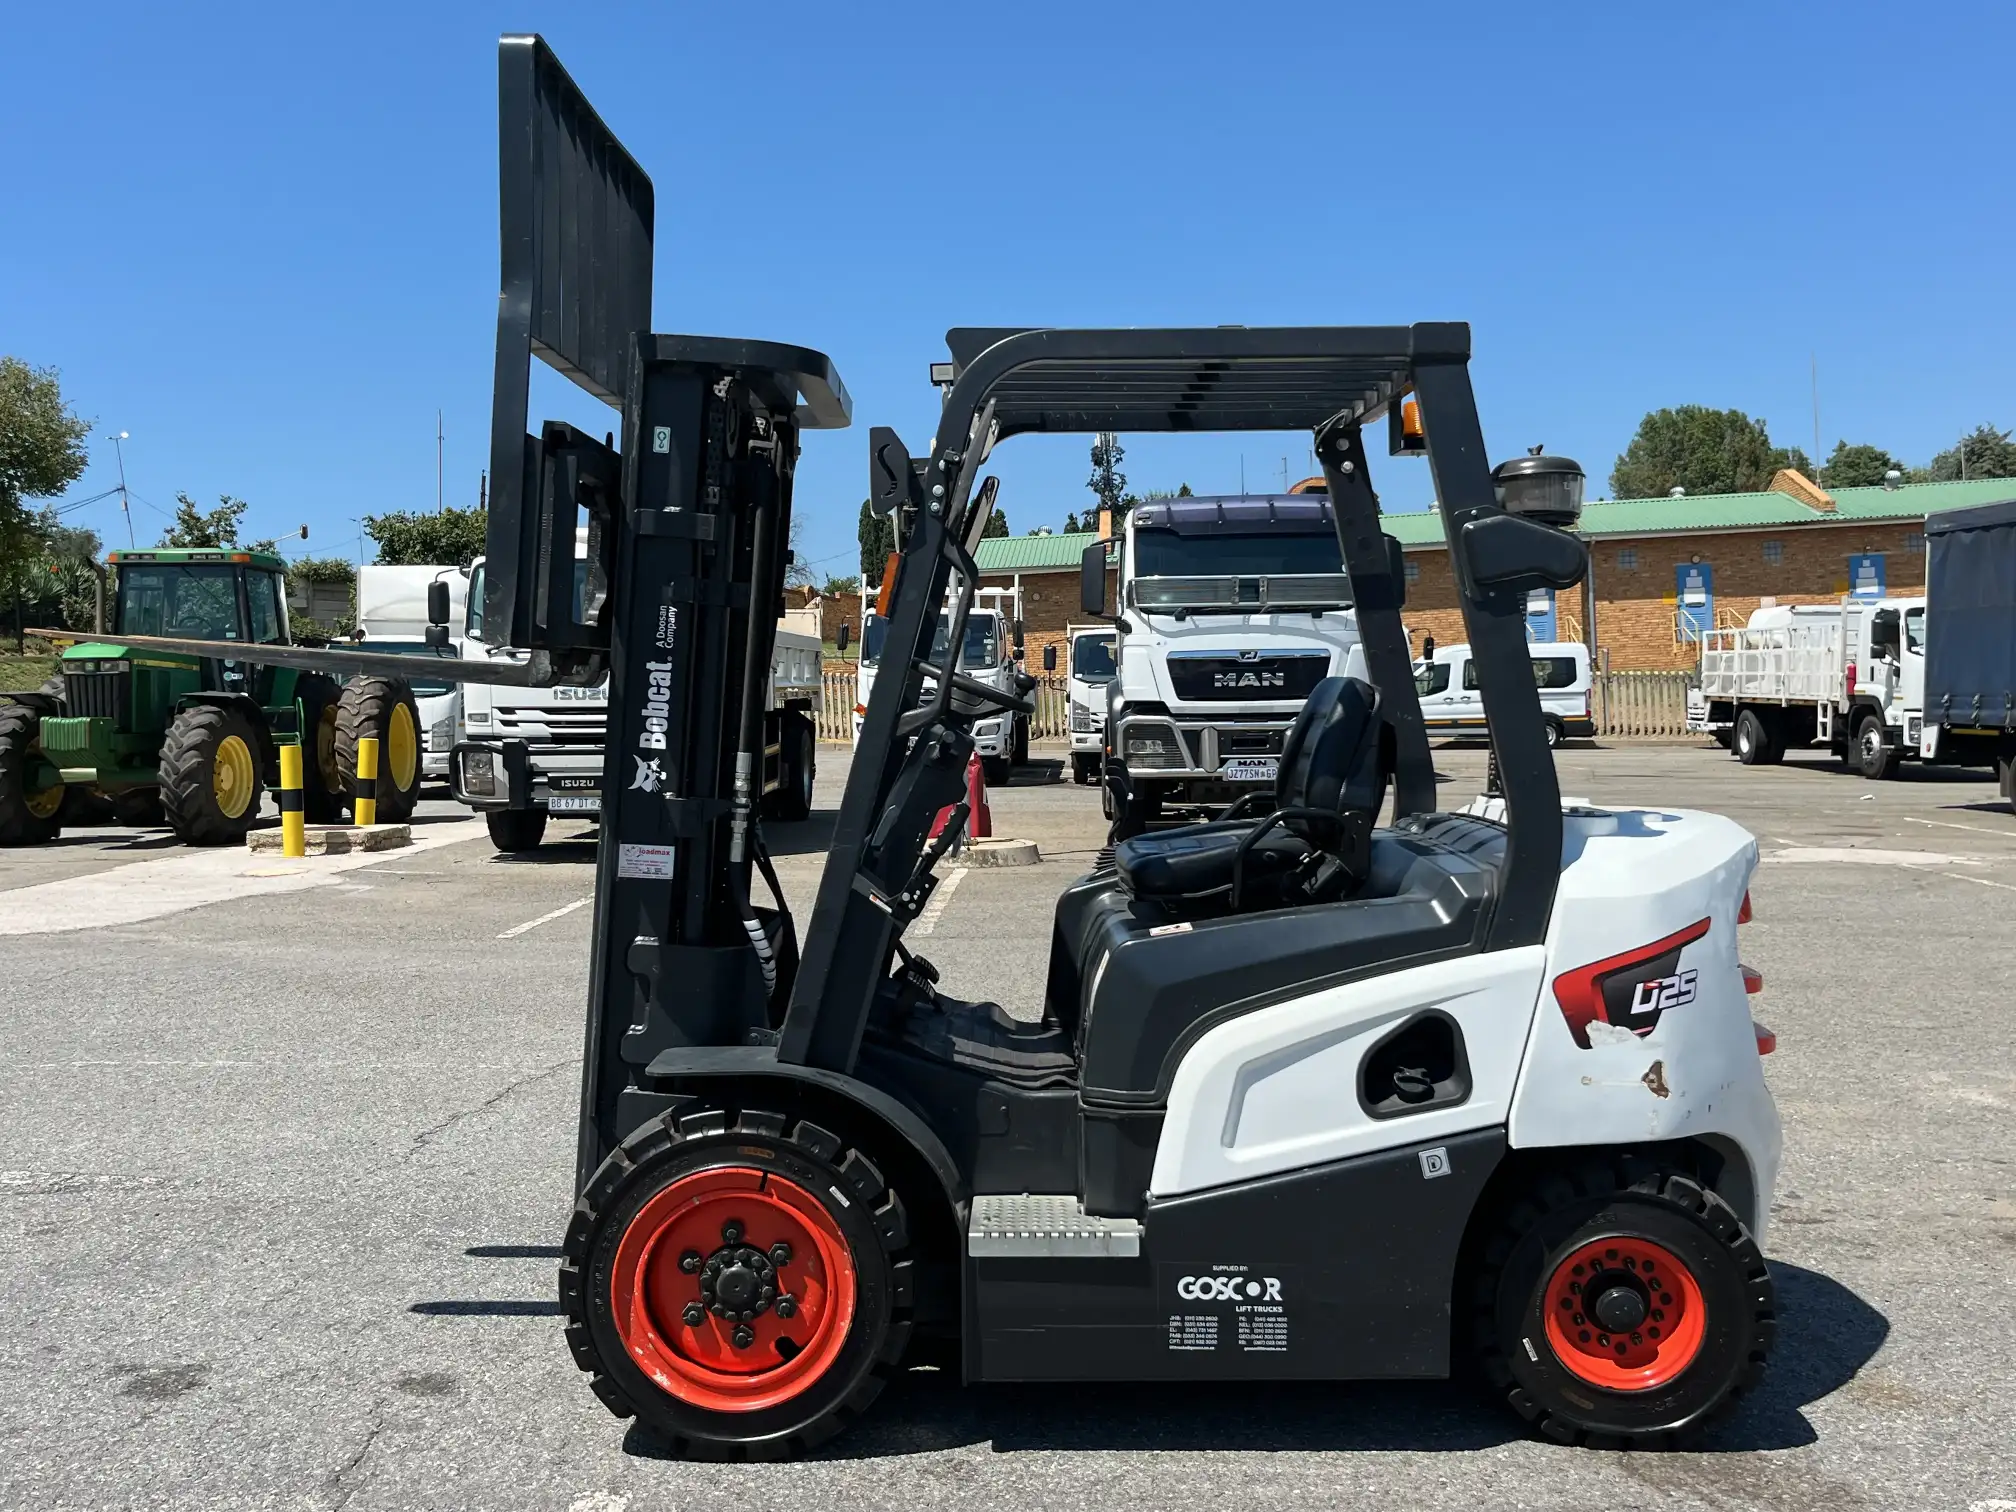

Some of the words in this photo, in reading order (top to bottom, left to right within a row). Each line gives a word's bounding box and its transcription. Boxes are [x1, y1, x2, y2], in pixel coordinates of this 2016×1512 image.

[656, 605, 668, 639] Doosan
[664, 606, 678, 649] Company
[1214, 672, 1284, 687] MAN
[639, 661, 673, 750] Bobcat
[561, 779, 595, 787] ISUZU
[639, 848, 671, 856] loadmax
